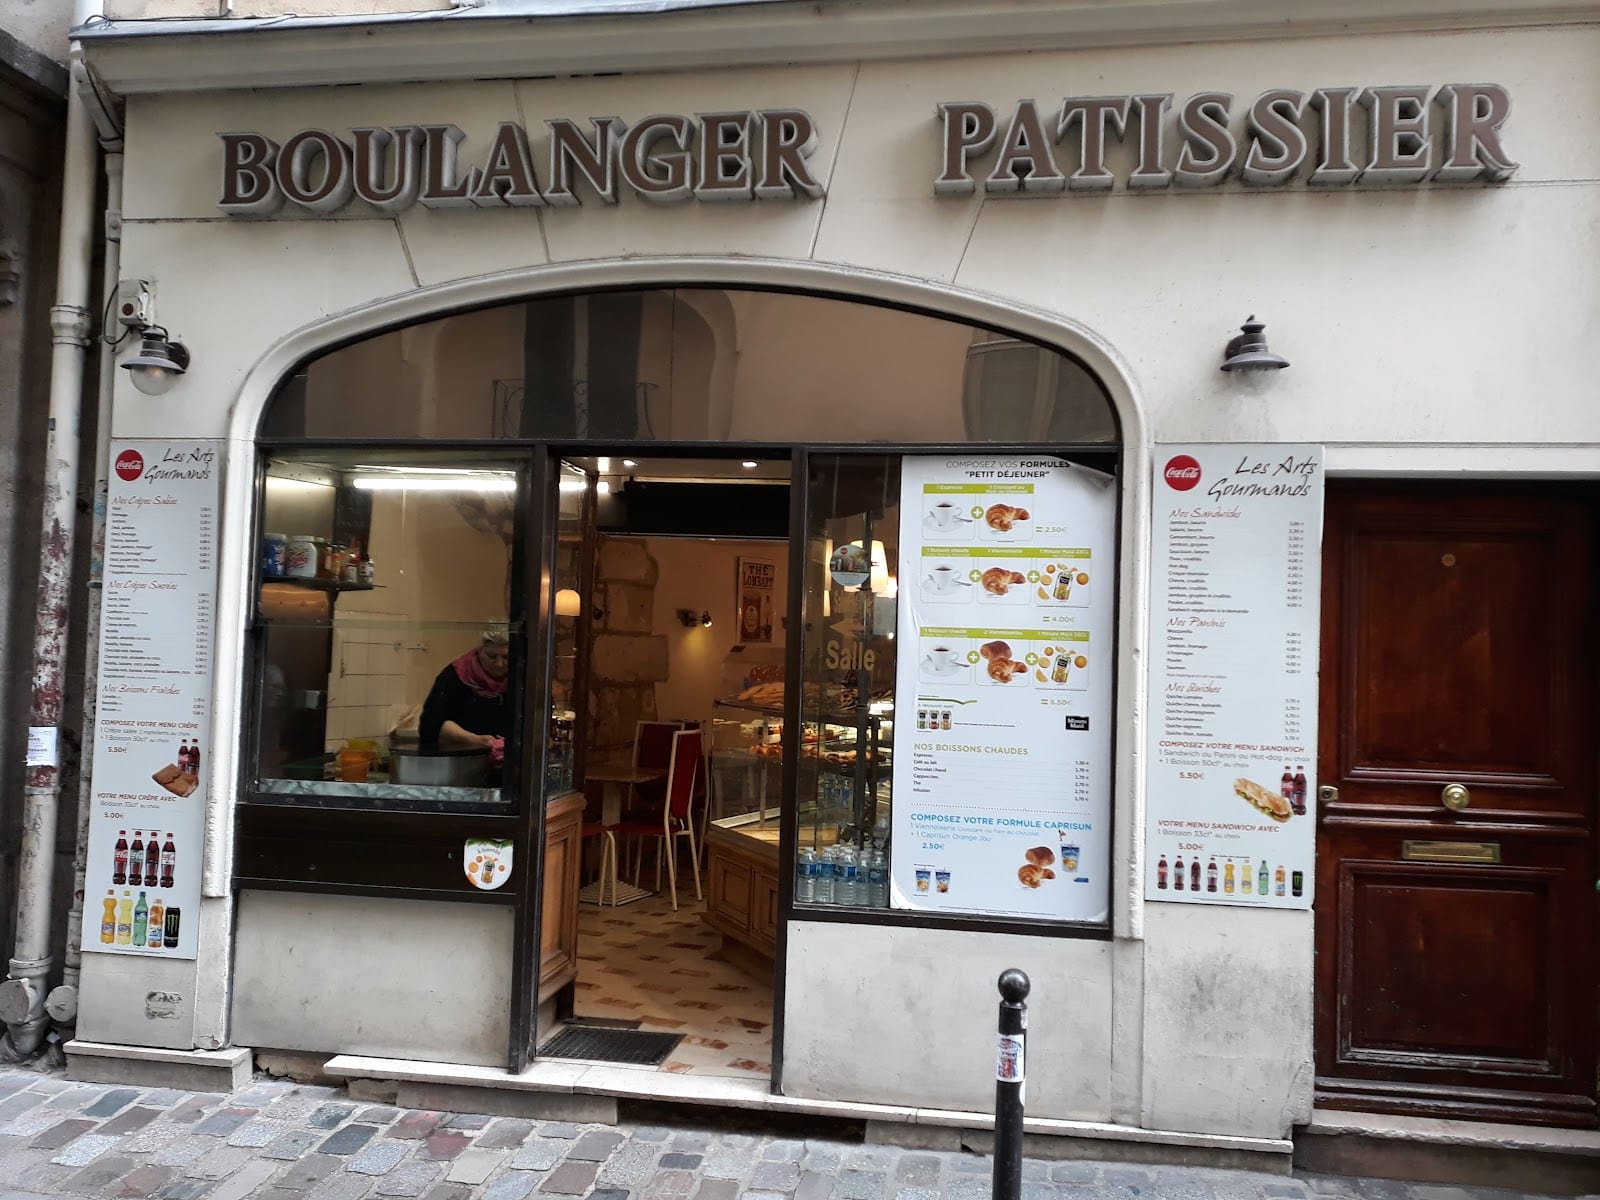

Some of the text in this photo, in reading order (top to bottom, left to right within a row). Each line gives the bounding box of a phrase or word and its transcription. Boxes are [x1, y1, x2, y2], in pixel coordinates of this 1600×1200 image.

[934, 82, 1519, 195] PATISSIER
[216, 108, 826, 215] BOULANGER
[163, 447, 215, 464] Les Arts
[946, 460, 1070, 468] COMPOSEZ VOS FORMULES
[1235, 455, 1318, 477] Les Arts
[144, 461, 211, 484] Gourmands
[1165, 466, 1201, 478] Coca-Cola
[1208, 473, 1312, 502] Gourmands
[1168, 508, 1189, 519] Nos
[748, 565, 769, 576] THE
[1166, 616, 1185, 628] Nos
[826, 640, 875, 671] Salle
[1165, 682, 1185, 692] Nos
[936, 744, 982, 752] BOISSONS
[985, 746, 1028, 756] CHAUDES
[1160, 740, 1204, 748] COMPOSEZ
[1260, 744, 1304, 752] SANDWICH
[1251, 754, 1282, 762] Hot-dog
[1179, 772, 1204, 780] 5.50€
[911, 813, 1092, 830] COMPOSEZ VOTRE FORMULE CAPRISUN
[1158, 820, 1184, 828] VOTRE
[1211, 823, 1256, 831] SANDWICH
[921, 831, 950, 839] Caprisun
[953, 833, 978, 842] Orange
[922, 842, 944, 850] 2.50€
[1178, 842, 1204, 850] 5.00€
